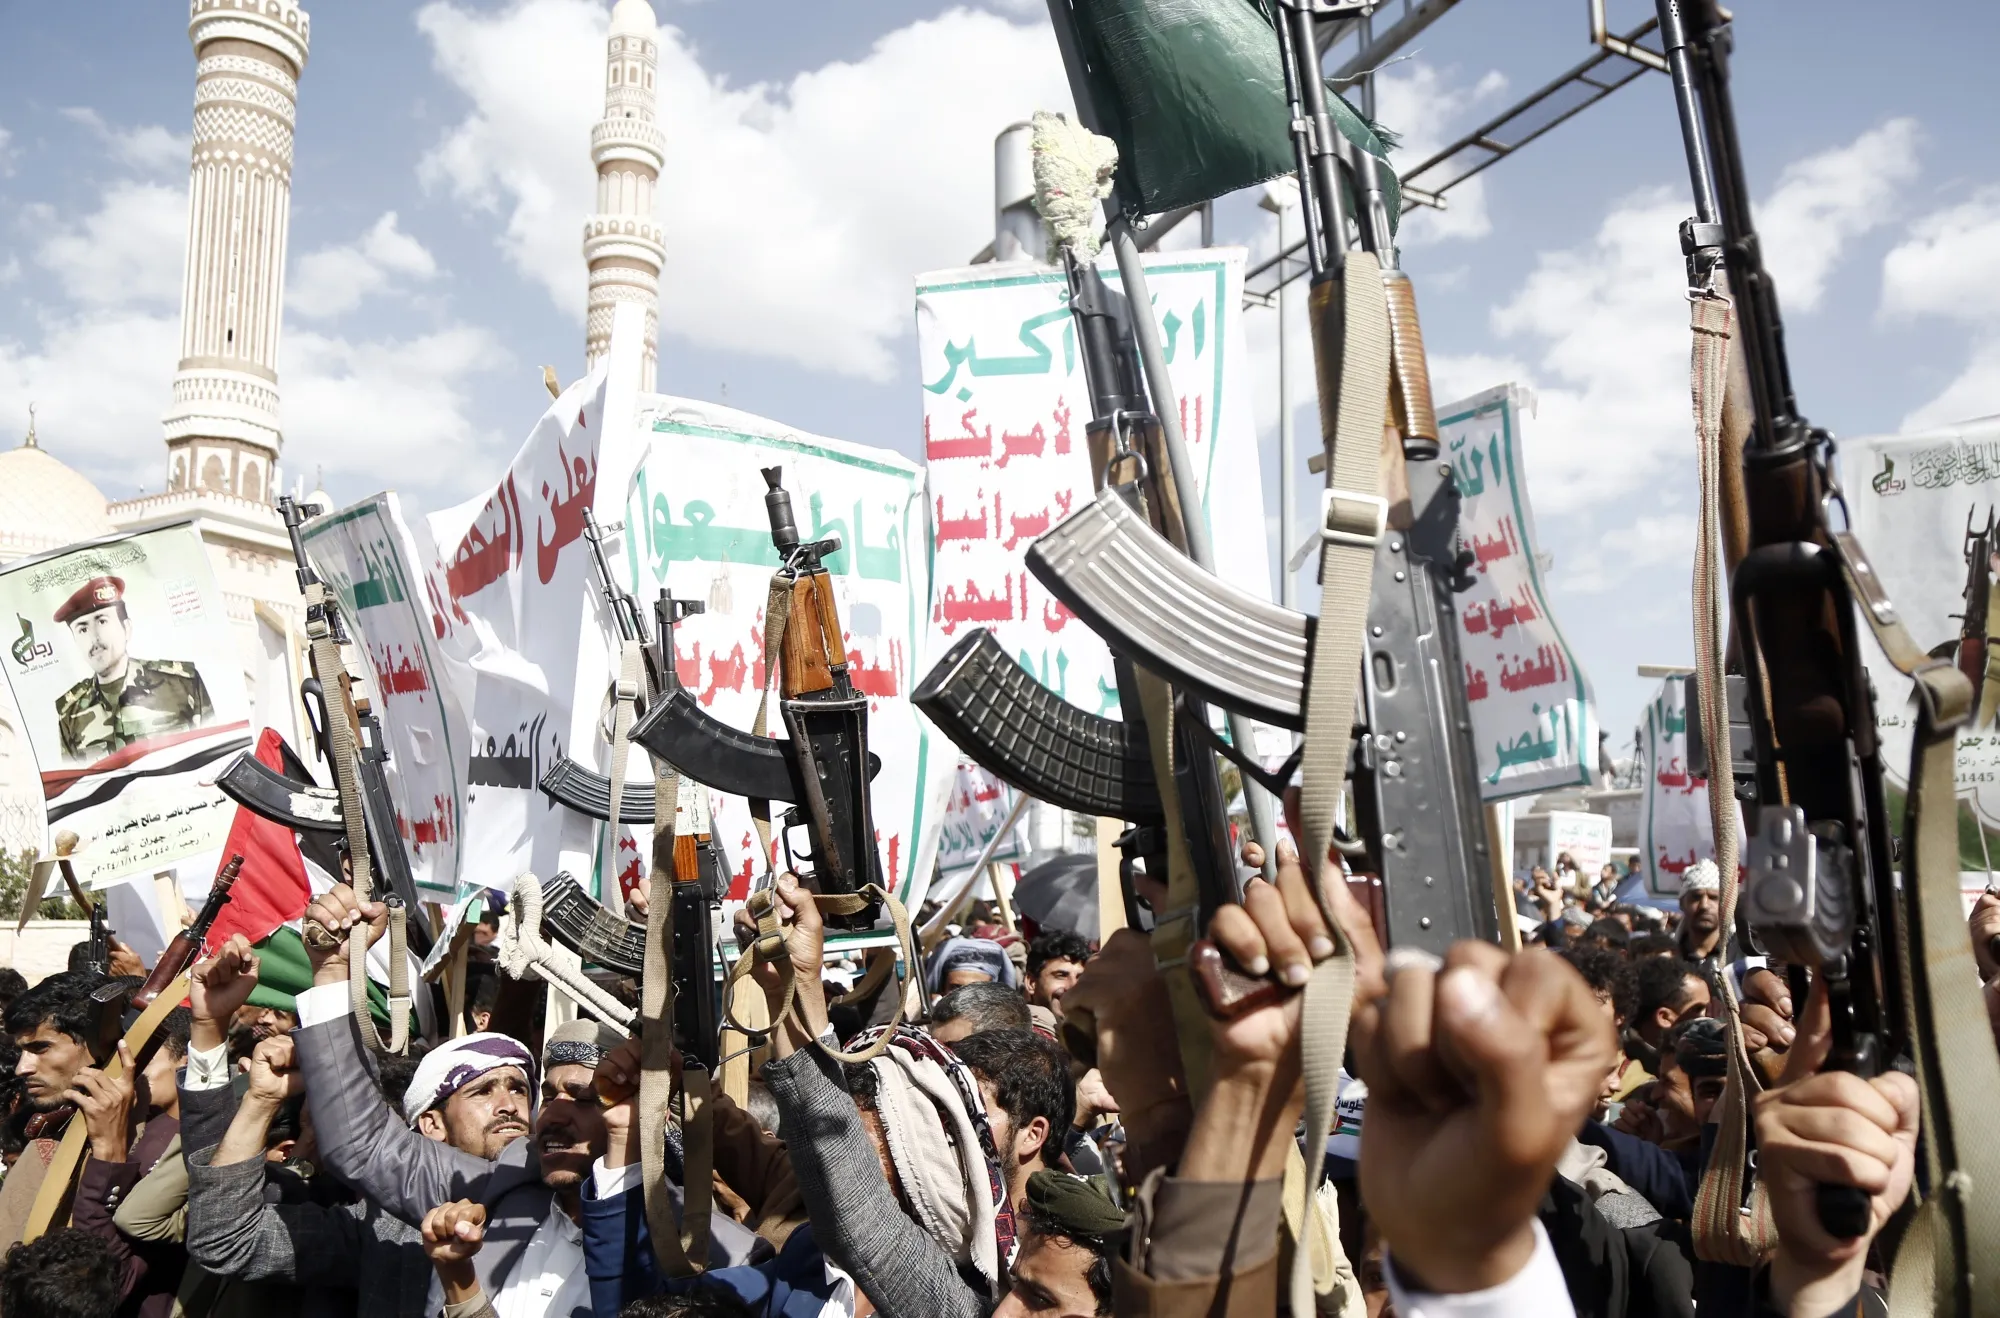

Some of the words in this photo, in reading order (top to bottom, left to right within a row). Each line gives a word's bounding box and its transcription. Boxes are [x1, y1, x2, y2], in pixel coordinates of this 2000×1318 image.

[922, 288, 1076, 404] أكبر
[925, 394, 1072, 471] لأمريكا
[636, 465, 902, 586] قاطعوا
[932, 570, 1028, 636] اليهود
[1463, 580, 1544, 641] الموت
[22, 640, 53, 662] رجال
[1499, 640, 1568, 693] اللعنة
[1464, 661, 1489, 703] عل
[1486, 701, 1571, 786] النصر
[140, 813, 161, 828] صالح
[164, 808, 184, 822] ناصر
[185, 802, 208, 815] حسين
[211, 795, 227, 809] علي
[140, 835, 166, 849] جهران
